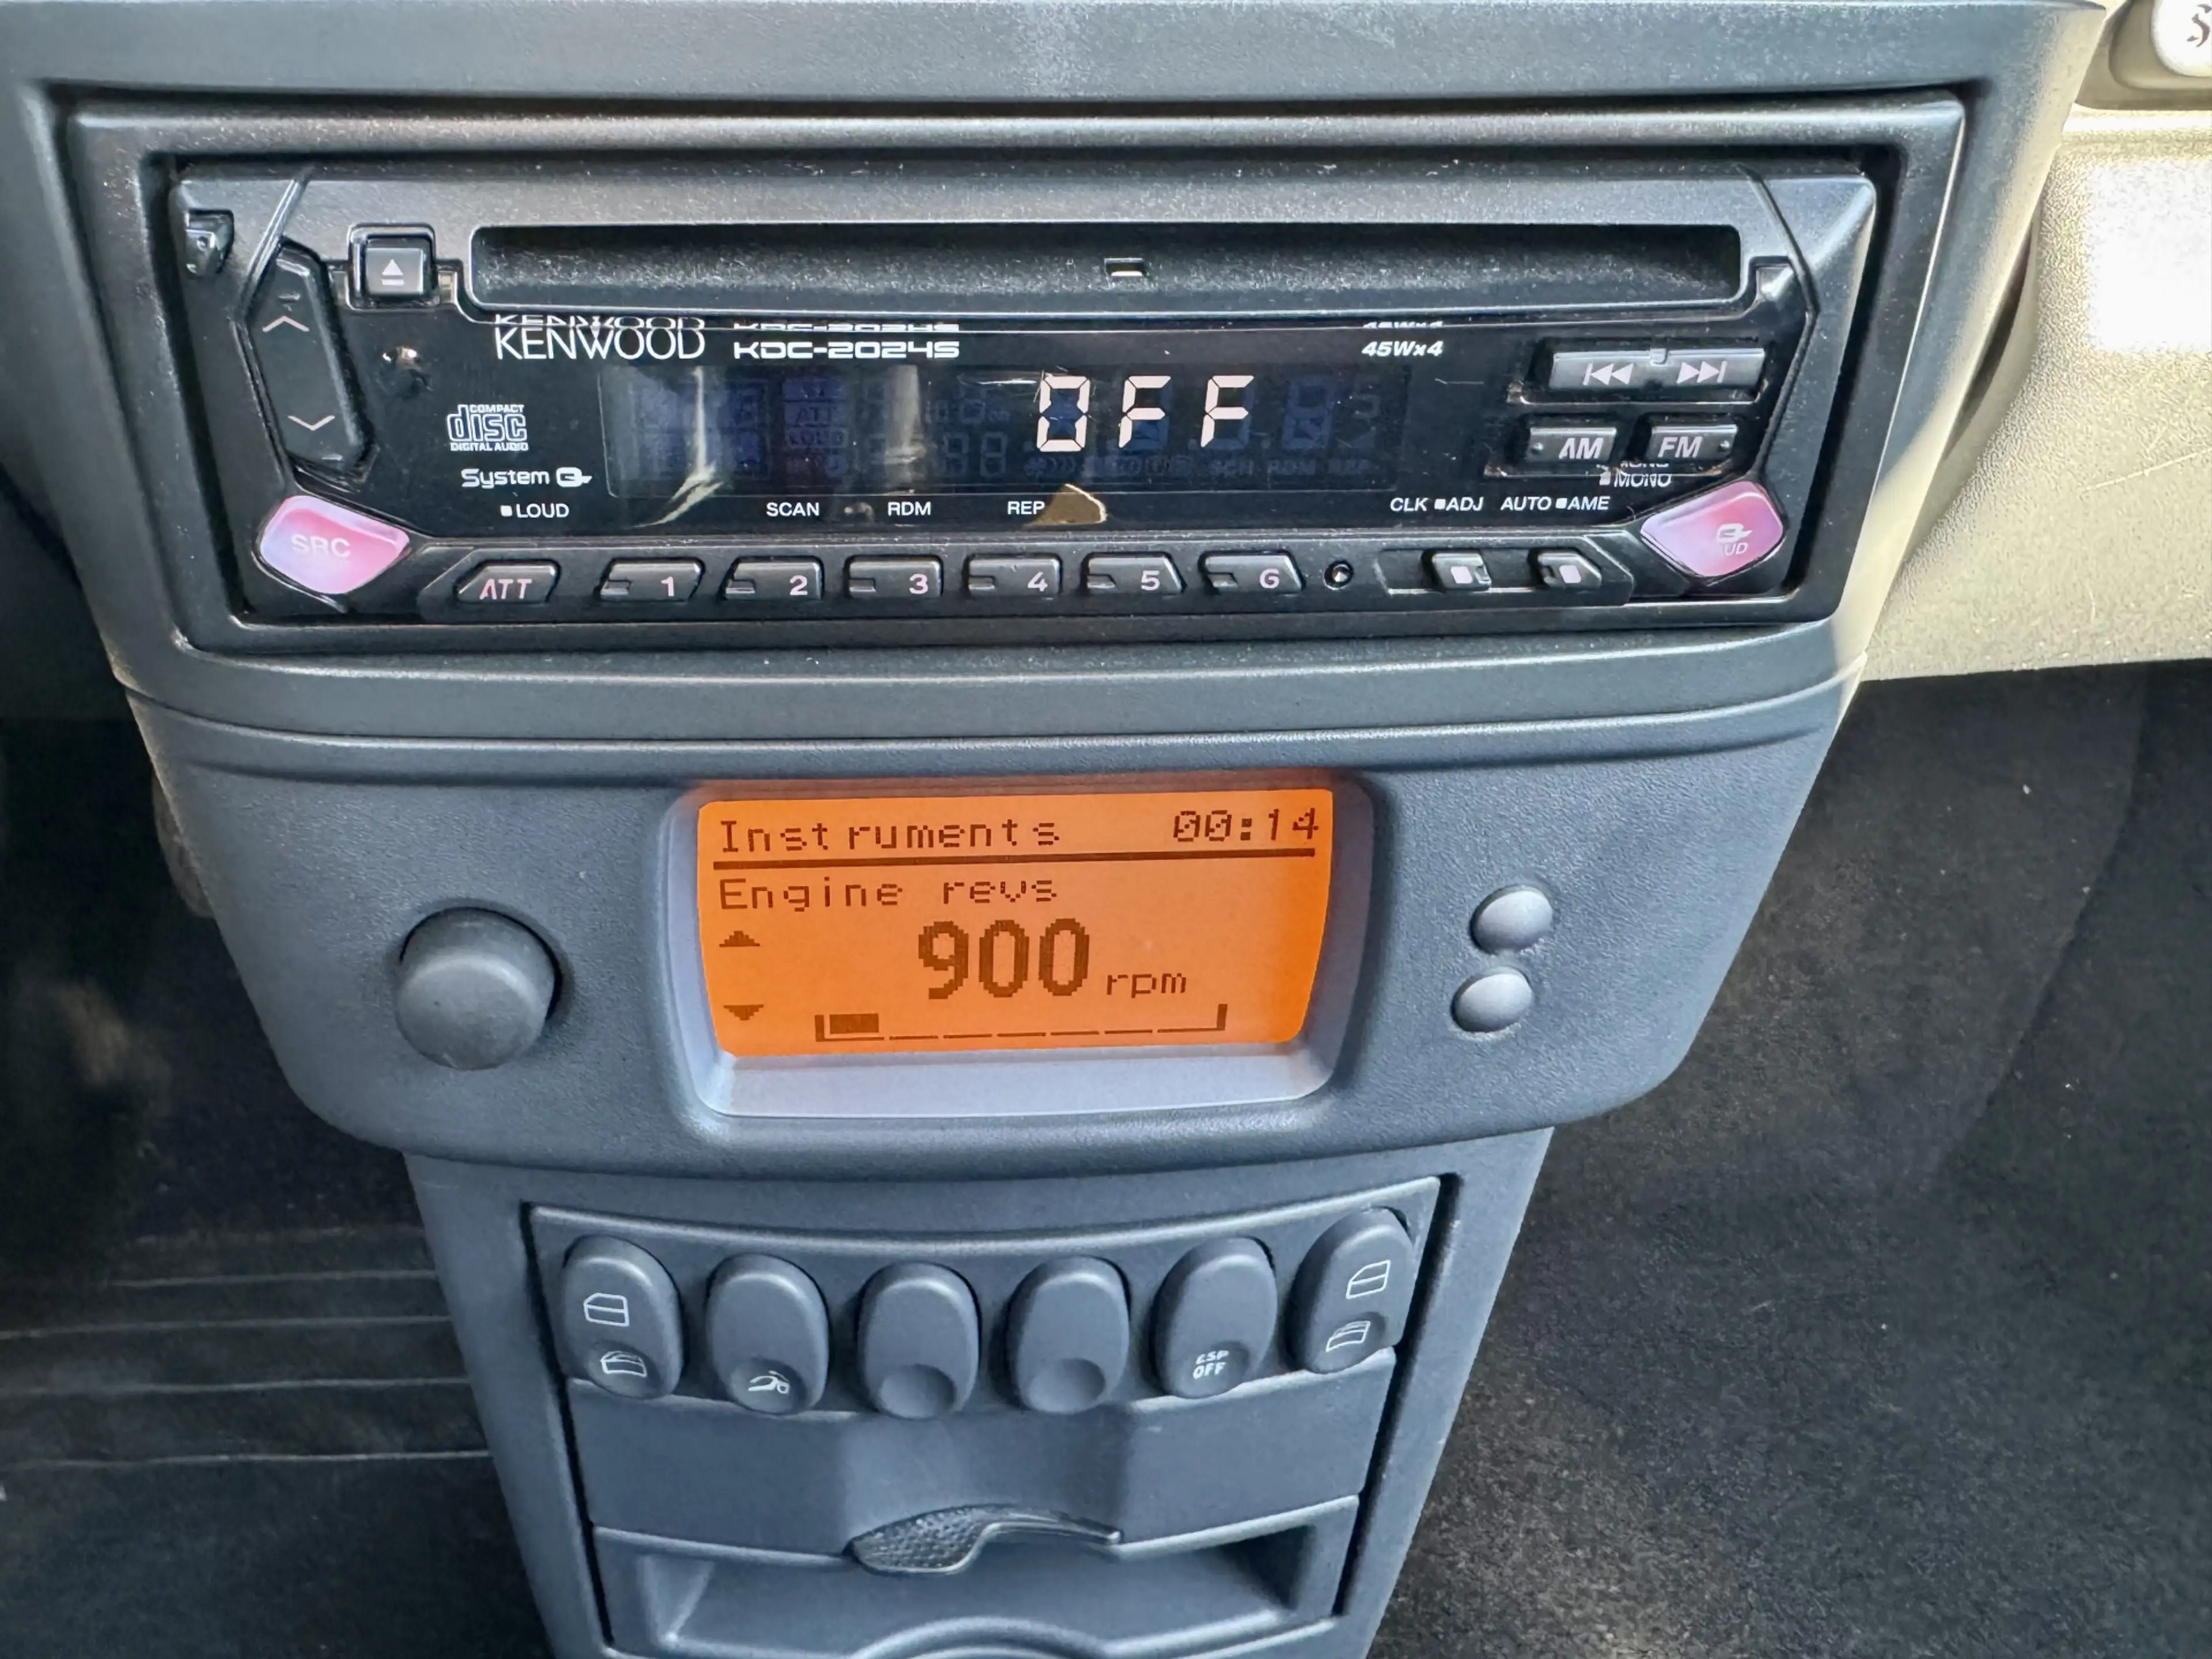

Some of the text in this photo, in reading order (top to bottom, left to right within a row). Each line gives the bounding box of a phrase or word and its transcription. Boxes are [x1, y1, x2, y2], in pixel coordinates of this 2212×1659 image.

[495, 327, 705, 359] KENWOOD
[734, 340, 959, 358] KDC-2024S
[1361, 340, 1444, 357] 45Wx4
[469, 404, 524, 413] COMPACT
[1037, 375, 1254, 452] OFF
[447, 404, 527, 442] disc
[450, 442, 529, 451] DIGITAL AUDIO
[1559, 437, 1604, 459] AM
[1658, 436, 1703, 458] FM
[461, 468, 550, 488] System
[1613, 473, 1672, 487] MONO
[516, 503, 569, 518] LOUD
[766, 502, 820, 517] SCAN
[888, 501, 931, 516] RDM
[1007, 501, 1045, 515] REP
[1390, 497, 1484, 512] CLK ADJ
[1500, 496, 1611, 511] AUTO AME
[291, 533, 351, 558] SRC
[479, 578, 532, 600] ATT
[661, 577, 675, 596] 1
[790, 575, 808, 596] 2
[909, 574, 929, 594] 3
[1027, 571, 1048, 592] 4
[1141, 570, 1160, 590] 5
[1173, 808, 1319, 842] 00:14
[720, 819, 1059, 852] Instruments
[719, 876, 1057, 912] Engine revs
[918, 918, 1187, 999] 900 rpm
[1192, 1362, 1226, 1380] OFF
